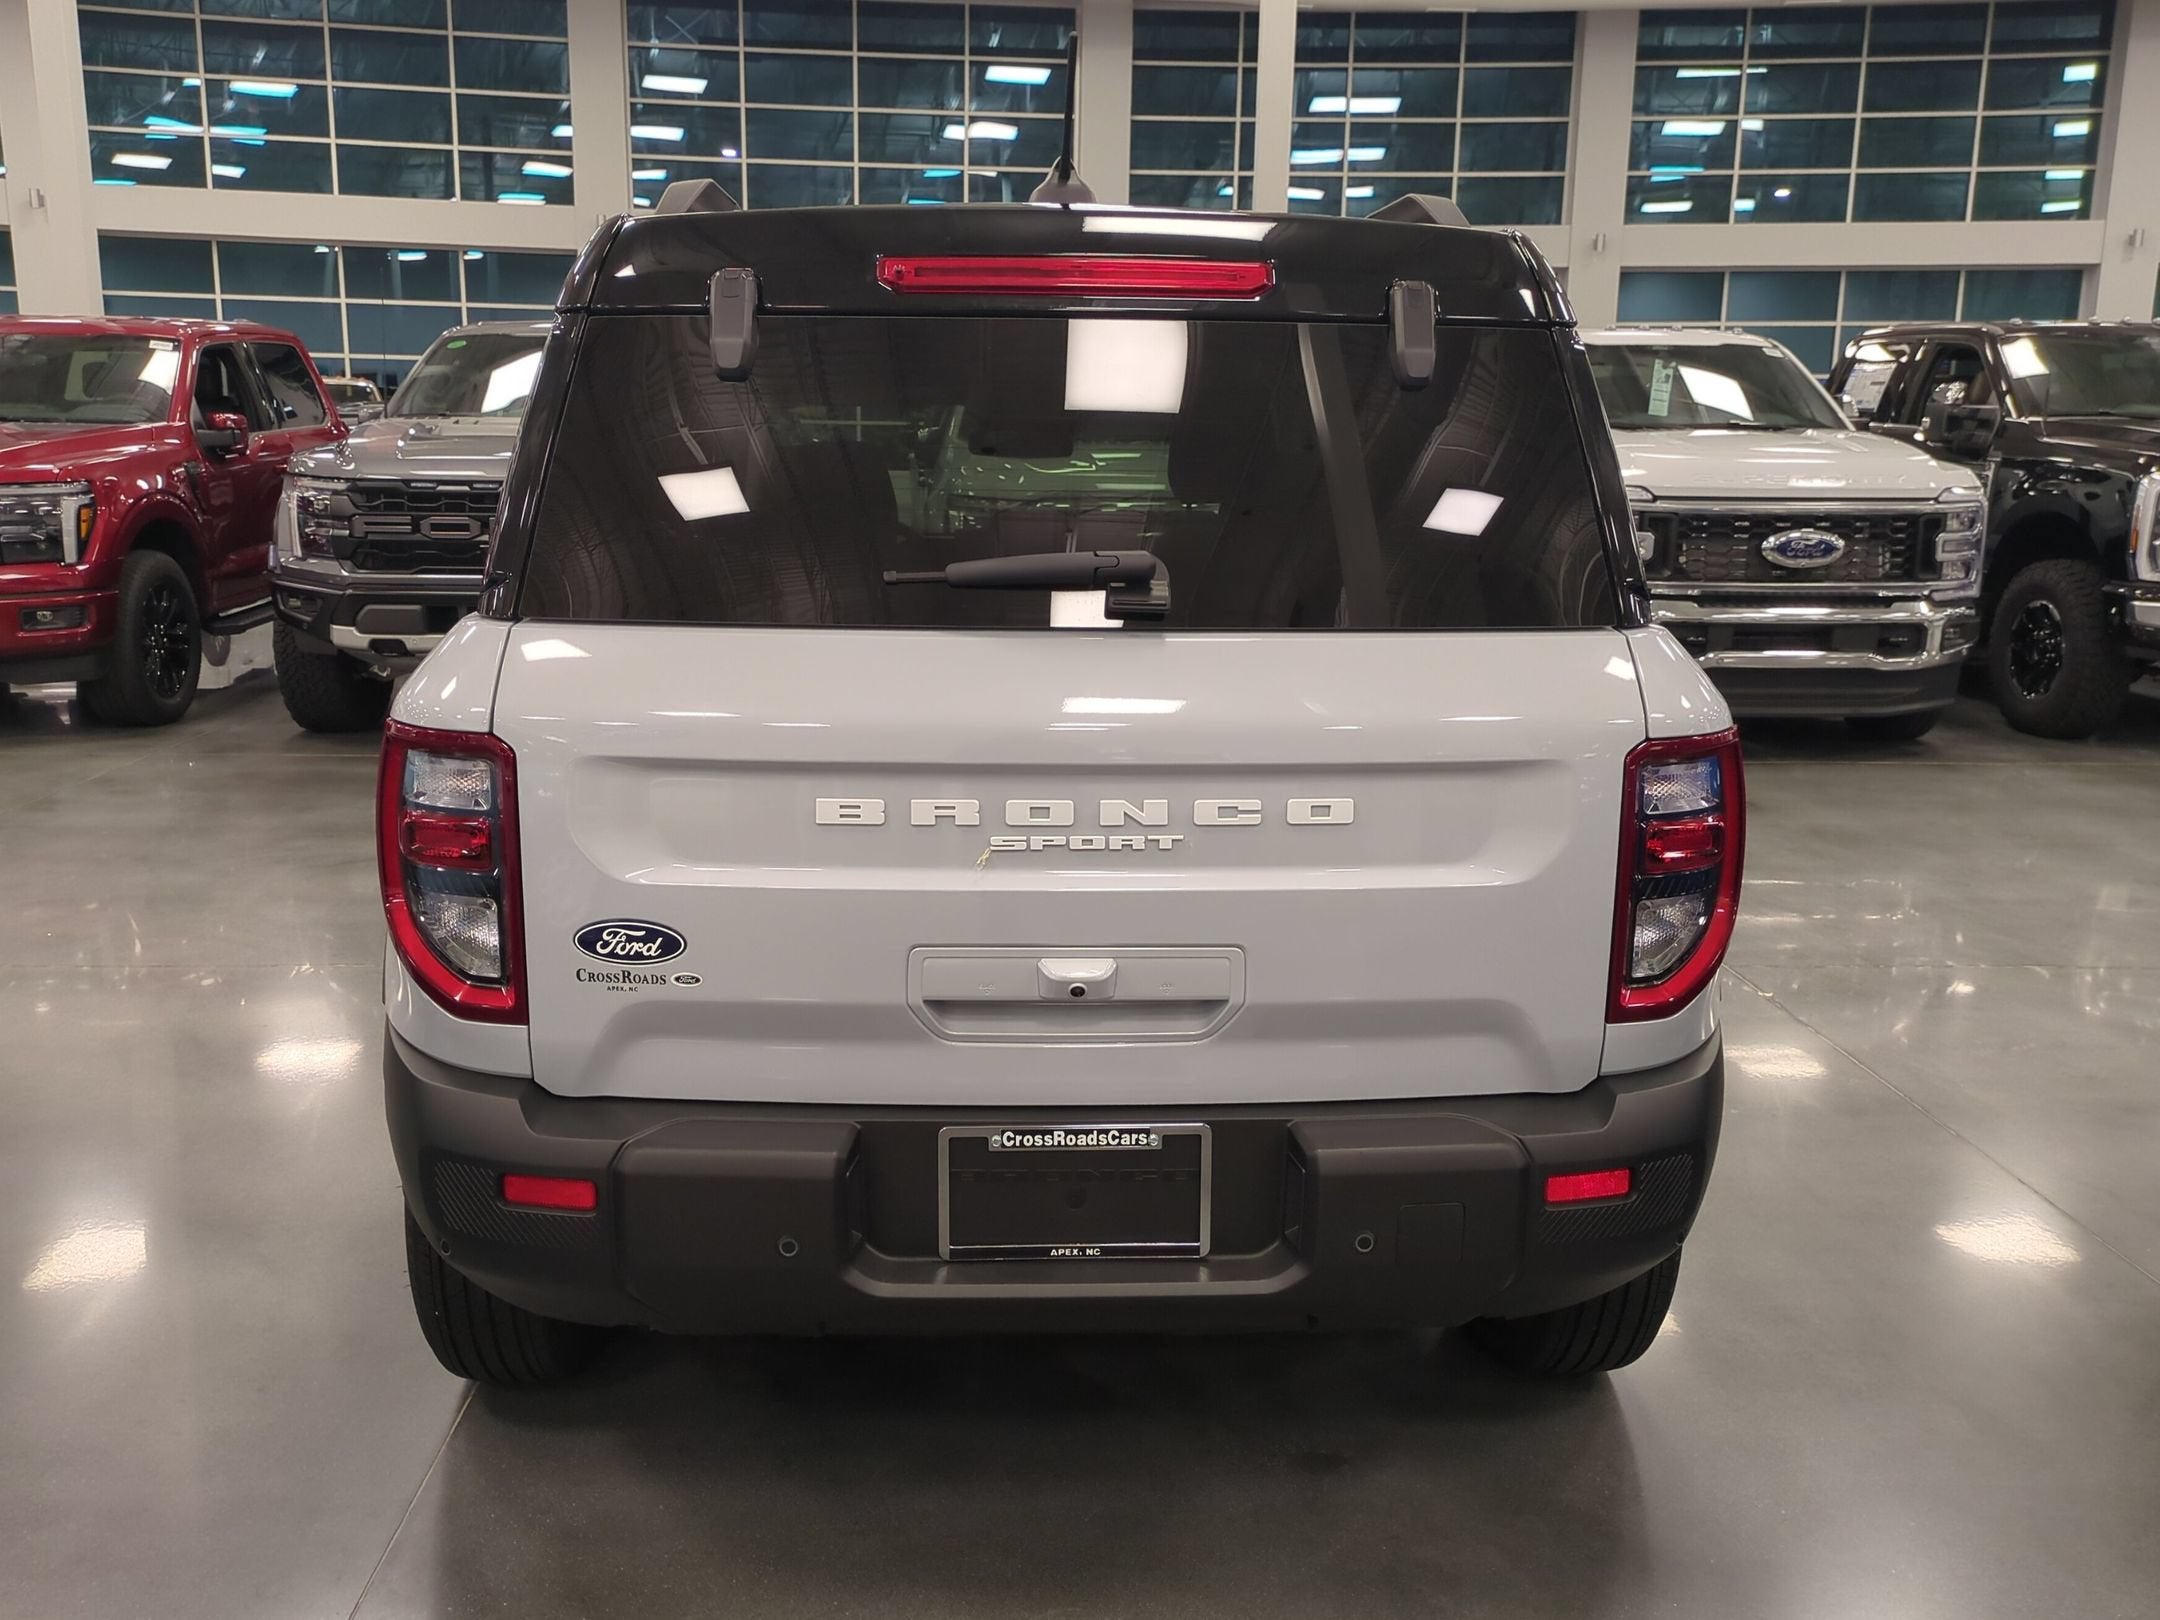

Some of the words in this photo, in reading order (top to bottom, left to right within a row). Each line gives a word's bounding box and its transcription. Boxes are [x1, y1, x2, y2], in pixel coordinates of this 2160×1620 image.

[815, 798, 1354, 825] BRONCO
[990, 835, 1184, 851] SPORT
[596, 928, 663, 956] Ford
[1002, 1130, 1148, 1147] CrossRoadsCars
[1050, 1248, 1083, 1256] APEX,
[1085, 1248, 1101, 1256] NC
